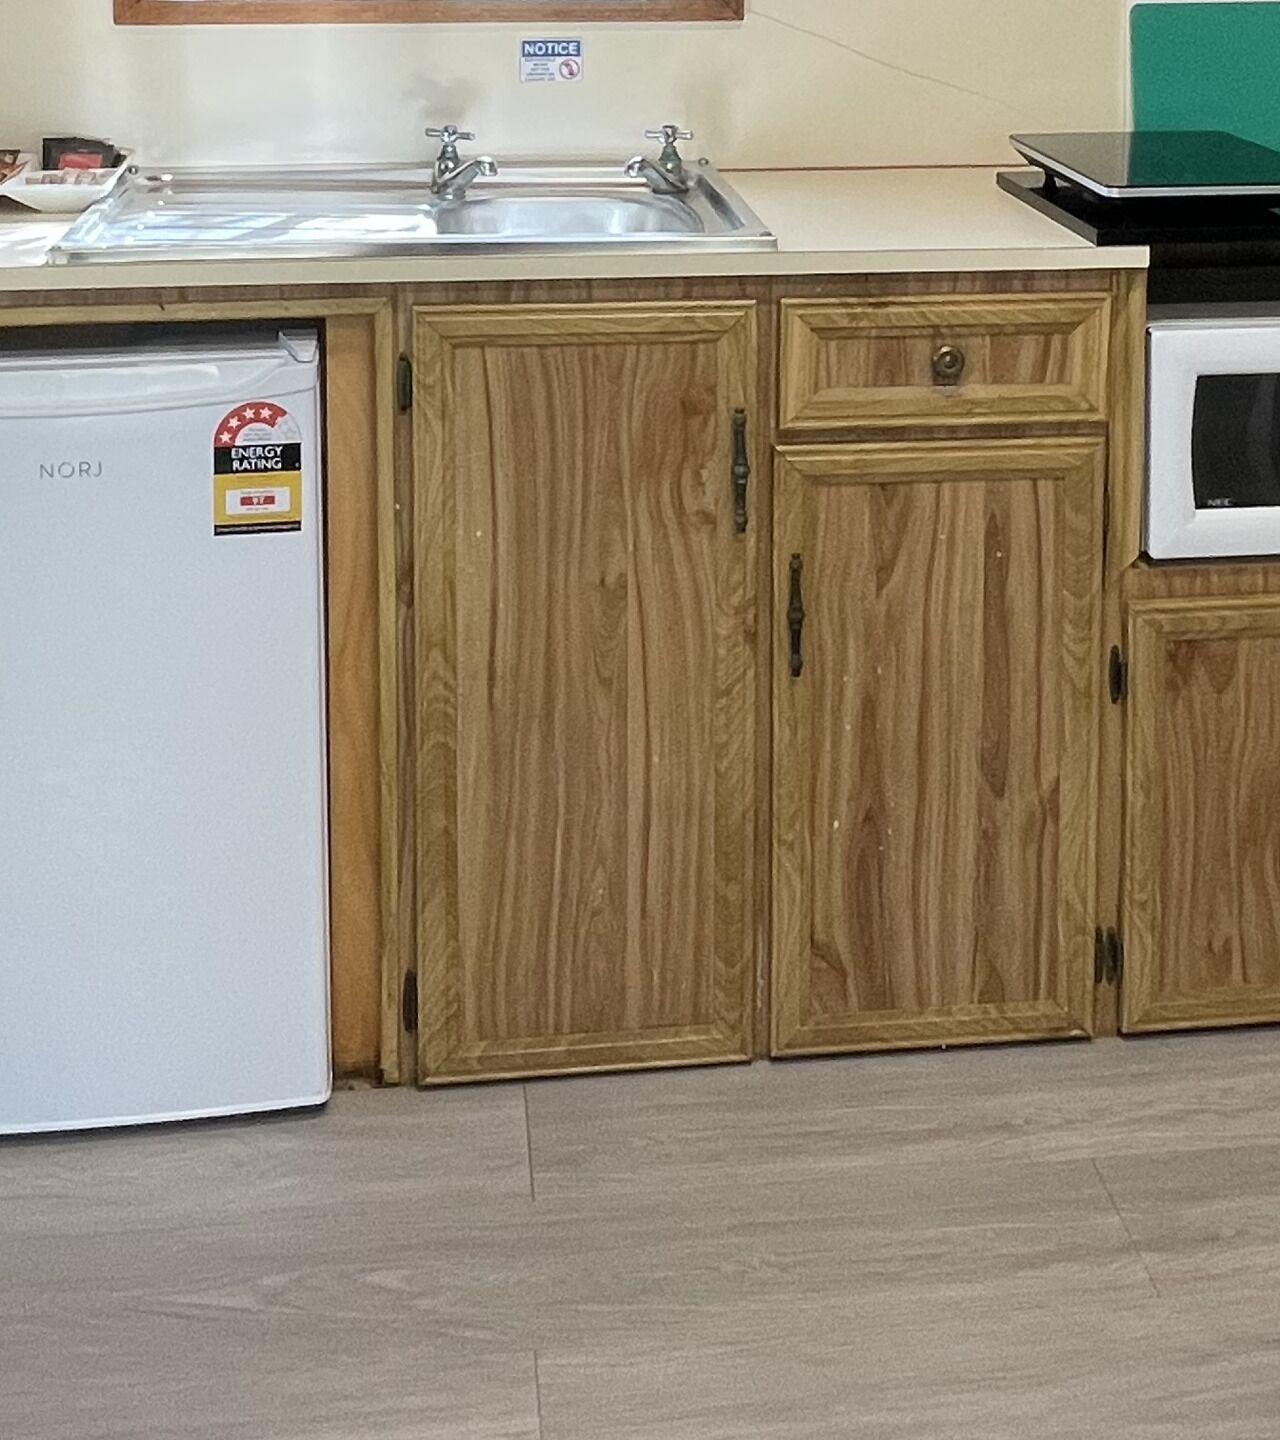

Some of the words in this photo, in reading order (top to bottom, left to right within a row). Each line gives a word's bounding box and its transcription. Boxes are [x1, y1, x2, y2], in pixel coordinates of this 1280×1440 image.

[524, 42, 579, 55] NOTICE
[231, 445, 284, 459] ENERGY
[39, 460, 103, 480] NORJ
[232, 458, 282, 471] RATING
